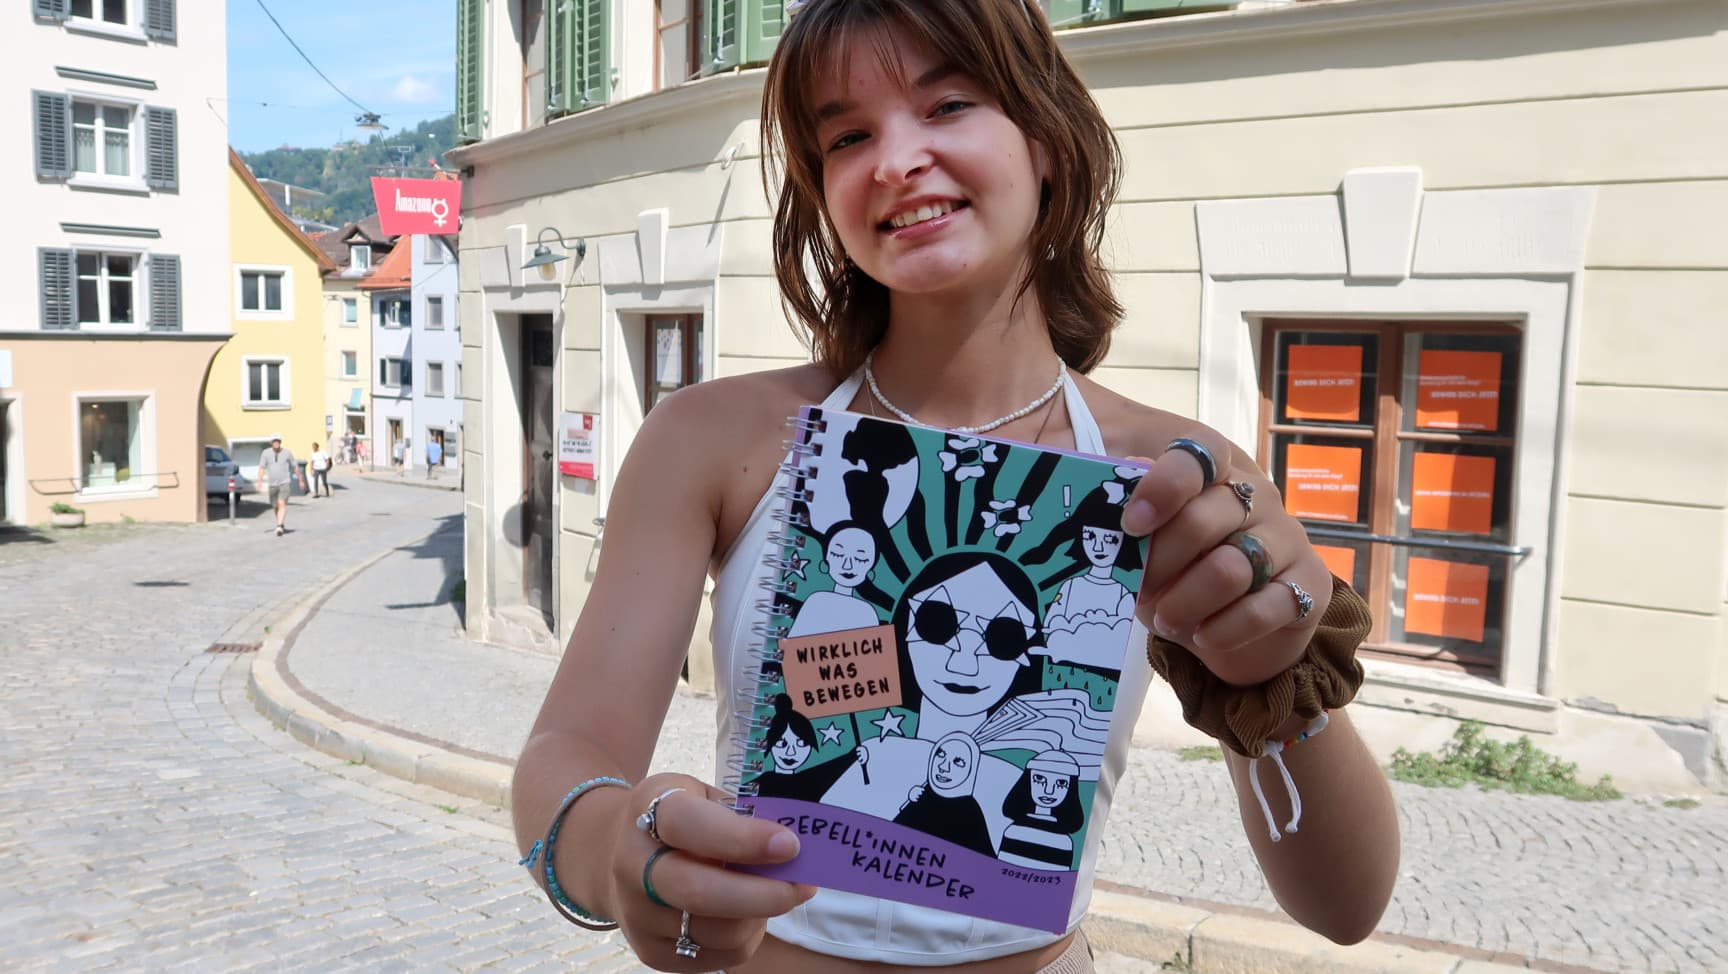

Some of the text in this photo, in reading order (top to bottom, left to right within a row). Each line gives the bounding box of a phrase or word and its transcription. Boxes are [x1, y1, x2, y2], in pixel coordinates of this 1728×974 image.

[796, 637, 883, 664] WIRKLICH
[818, 662, 858, 681] WAS
[803, 676, 890, 707] BEWEGEN
[851, 850, 976, 900] KALENDER
[999, 867, 1062, 886] 2022/2023
